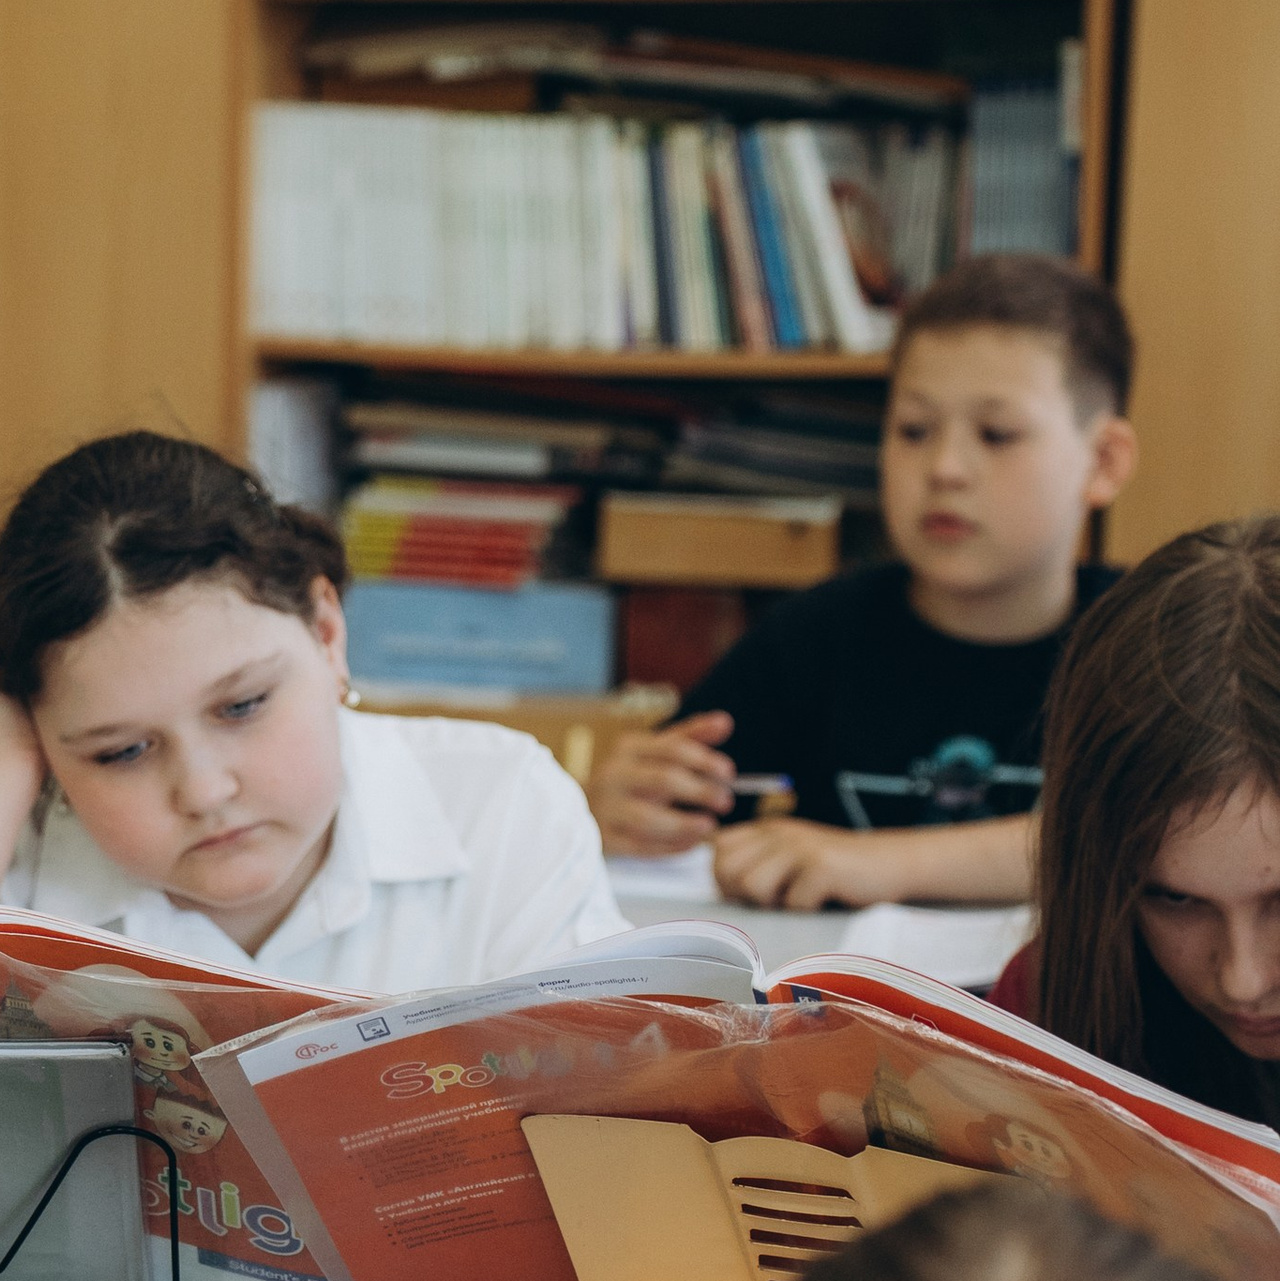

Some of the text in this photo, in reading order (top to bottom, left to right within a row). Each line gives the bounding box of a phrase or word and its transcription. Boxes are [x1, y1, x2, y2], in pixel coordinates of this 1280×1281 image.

[538, 978, 571, 988] форму
[402, 1006, 441, 1020] Учебник
[417, 1190, 445, 1203] УМК
